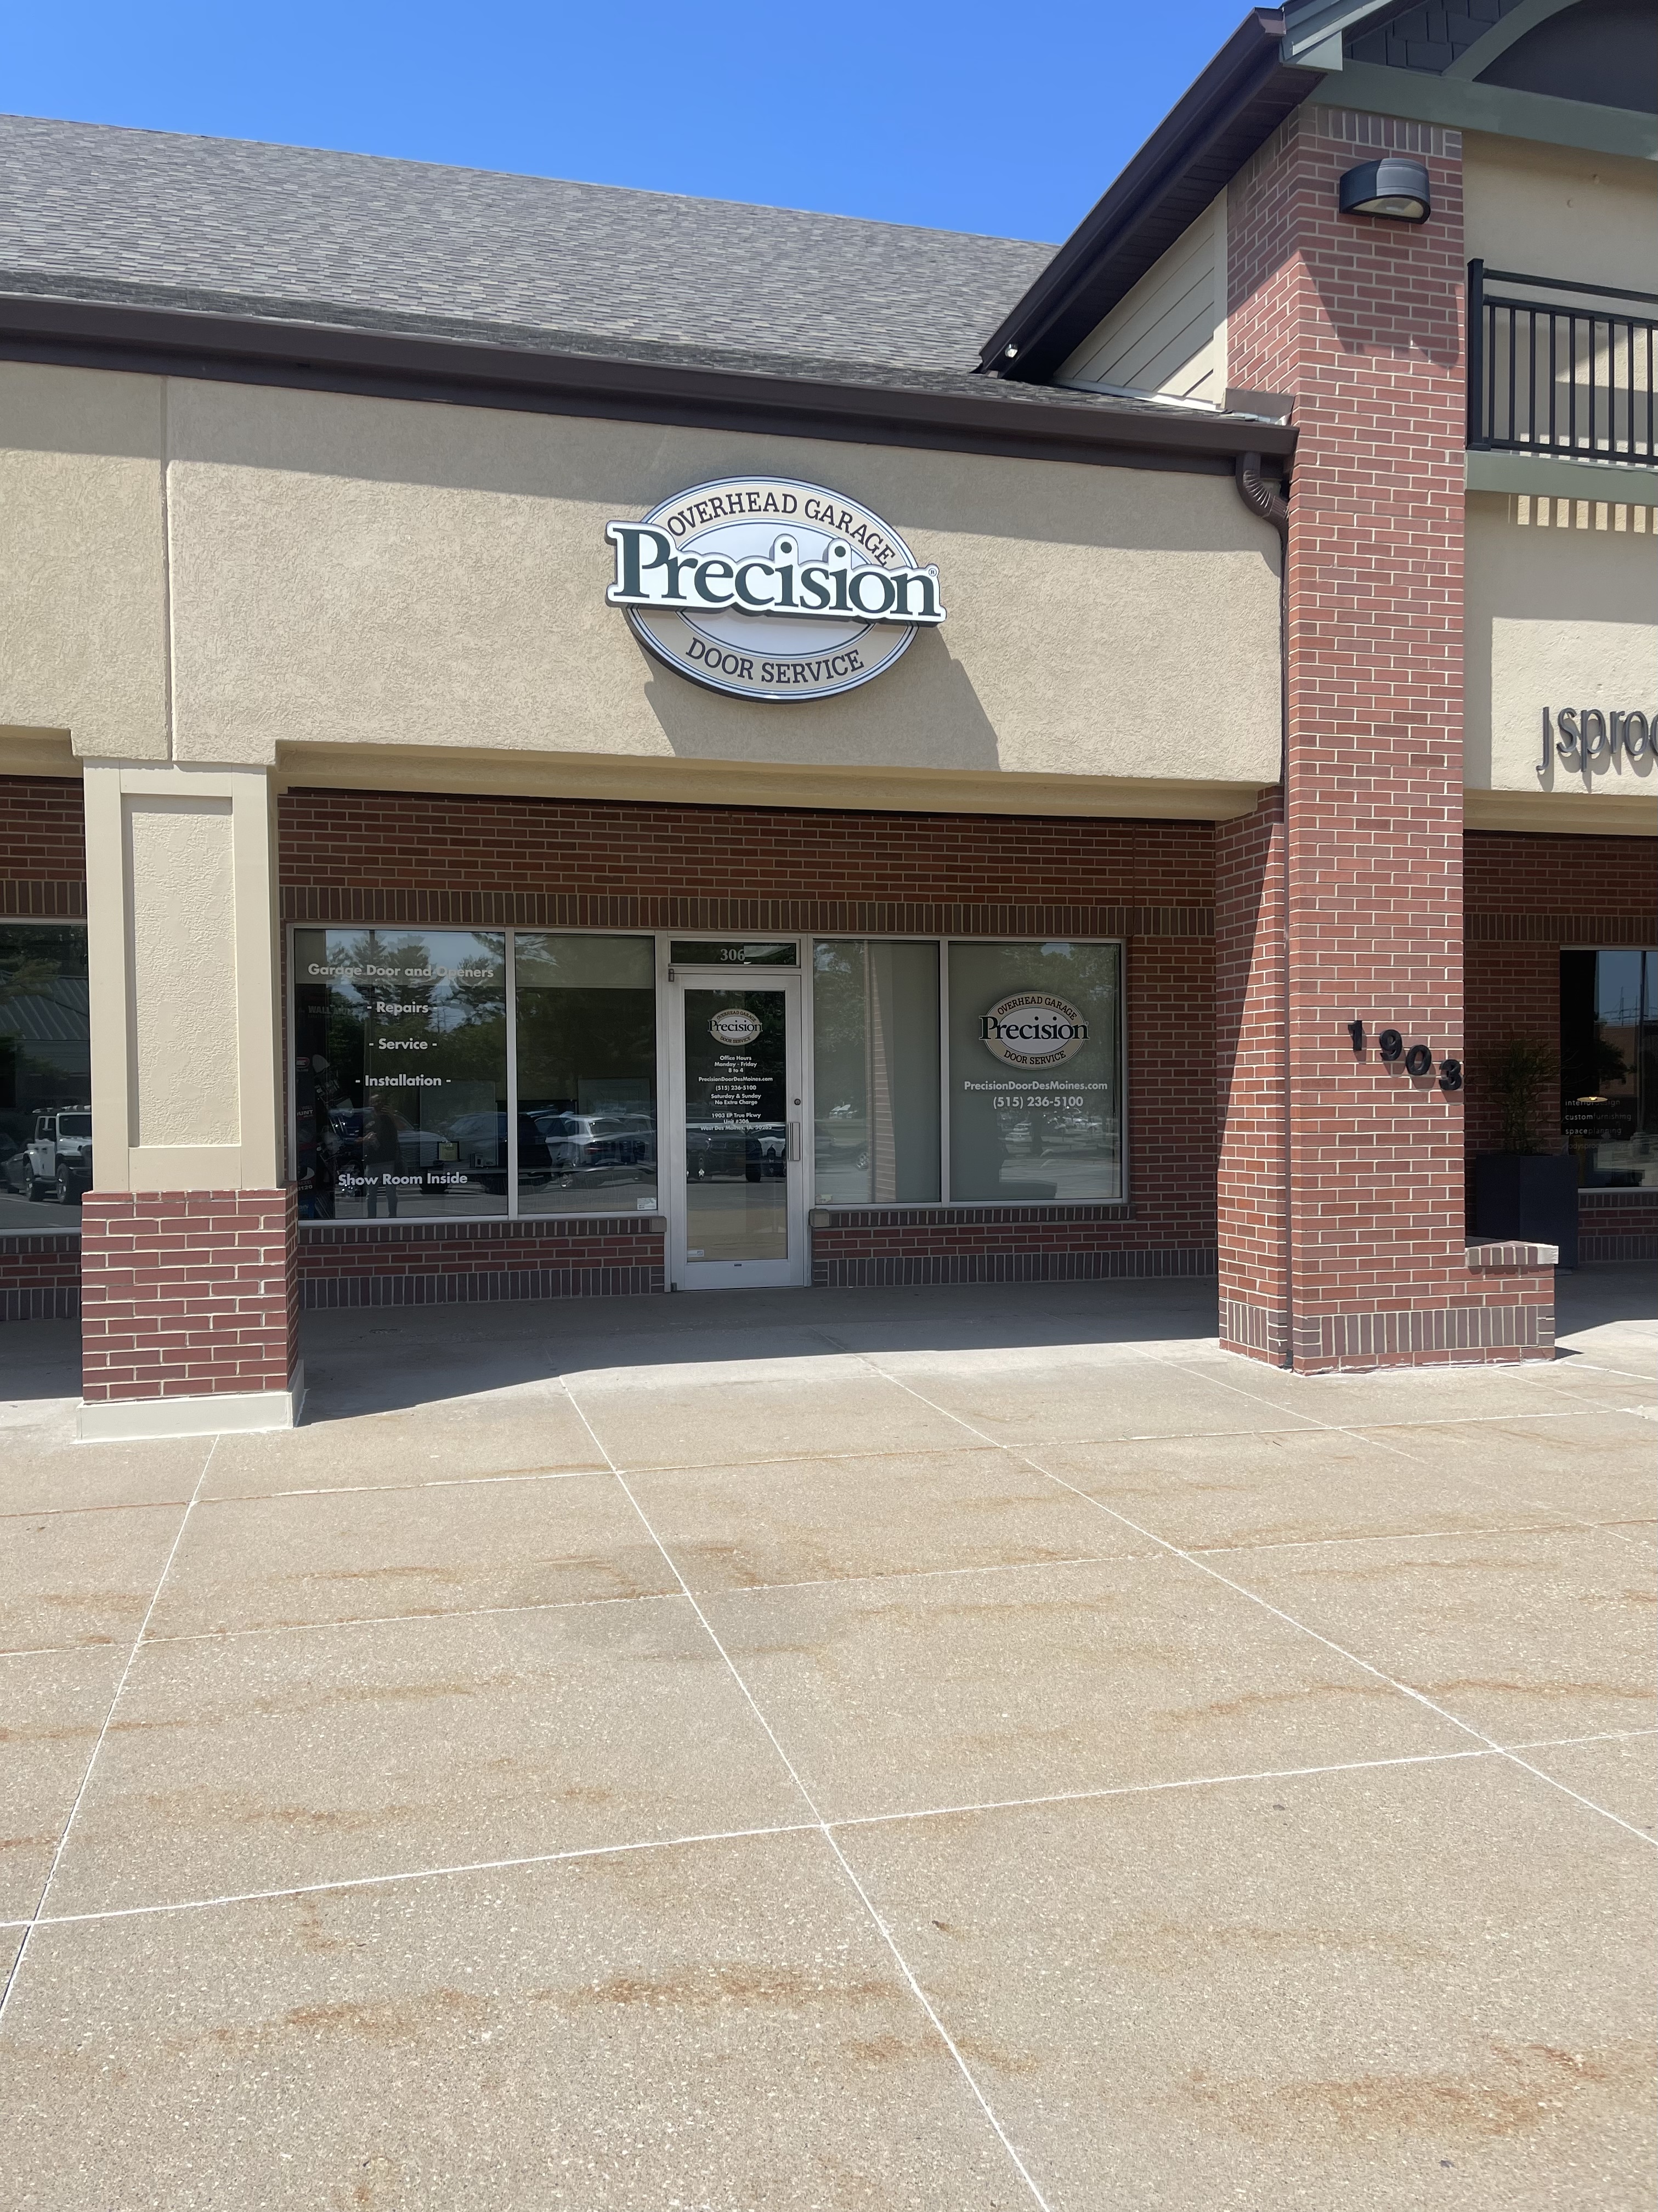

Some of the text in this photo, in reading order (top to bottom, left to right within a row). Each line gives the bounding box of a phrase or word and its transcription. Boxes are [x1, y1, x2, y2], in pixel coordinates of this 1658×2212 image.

[667, 492, 895, 565] OVERHEAD GARAGE
[686, 637, 864, 684] DOOR SERVICE
[720, 949, 745, 961] 306
[308, 963, 494, 979] Garage Door and Openers
[376, 1001, 429, 1016] Repairs
[997, 996, 1077, 1020] OVERHEAD GARAGE
[716, 1011, 756, 1022] OVERHEAD GARAGE
[708, 1020, 763, 1031] Precision
[979, 1016, 1089, 1040] Precision
[378, 1037, 428, 1049] Service
[1004, 1050, 1066, 1065] DOOR SERVICE
[1348, 1020, 1462, 1091] 1903
[365, 1074, 442, 1086] Installation
[964, 1081, 1108, 1090] PrecisionDoorDesMoines.com
[993, 1096, 1084, 1109] (515) 236-5100
[337, 1172, 468, 1186] Show Room Inside
